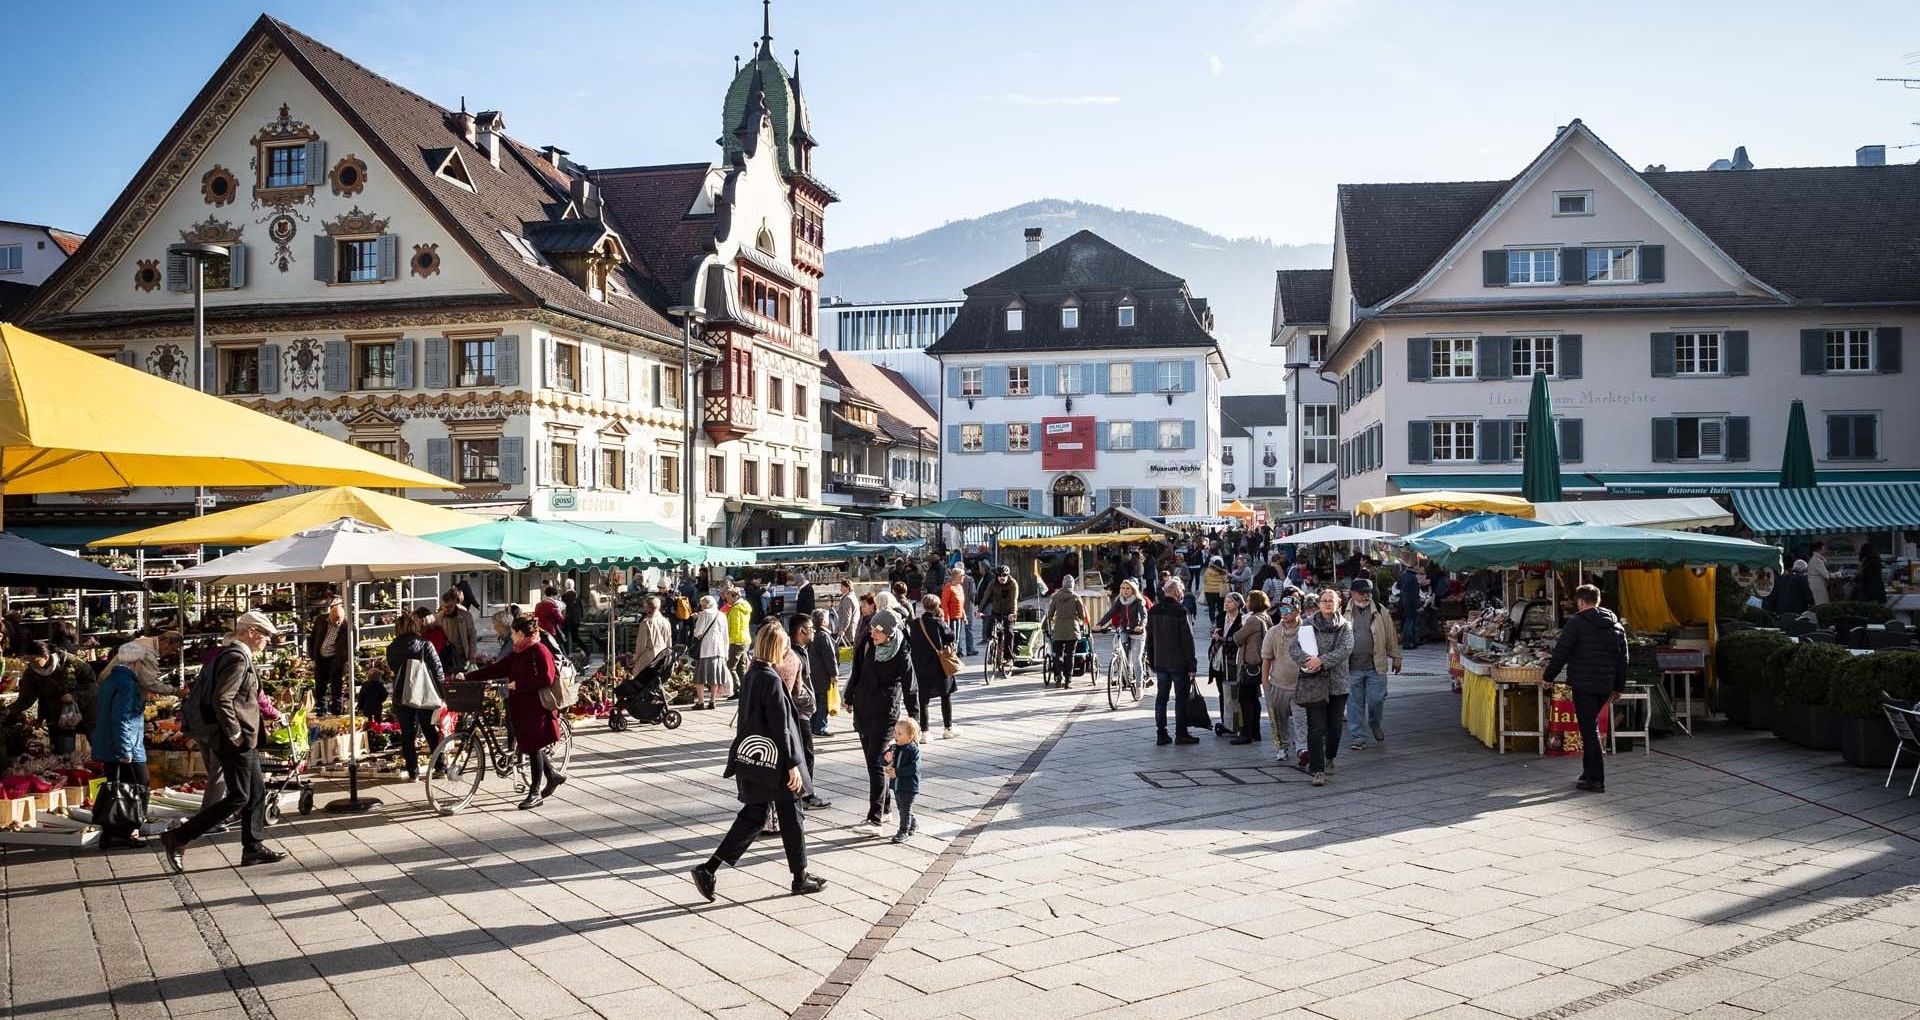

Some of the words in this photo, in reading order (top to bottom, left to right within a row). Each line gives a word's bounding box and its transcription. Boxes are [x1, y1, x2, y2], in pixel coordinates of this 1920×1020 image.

[1150, 464, 1179, 472] Museum
[1180, 463, 1201, 472] Archiv
[1667, 486, 1708, 494] Ristorante
